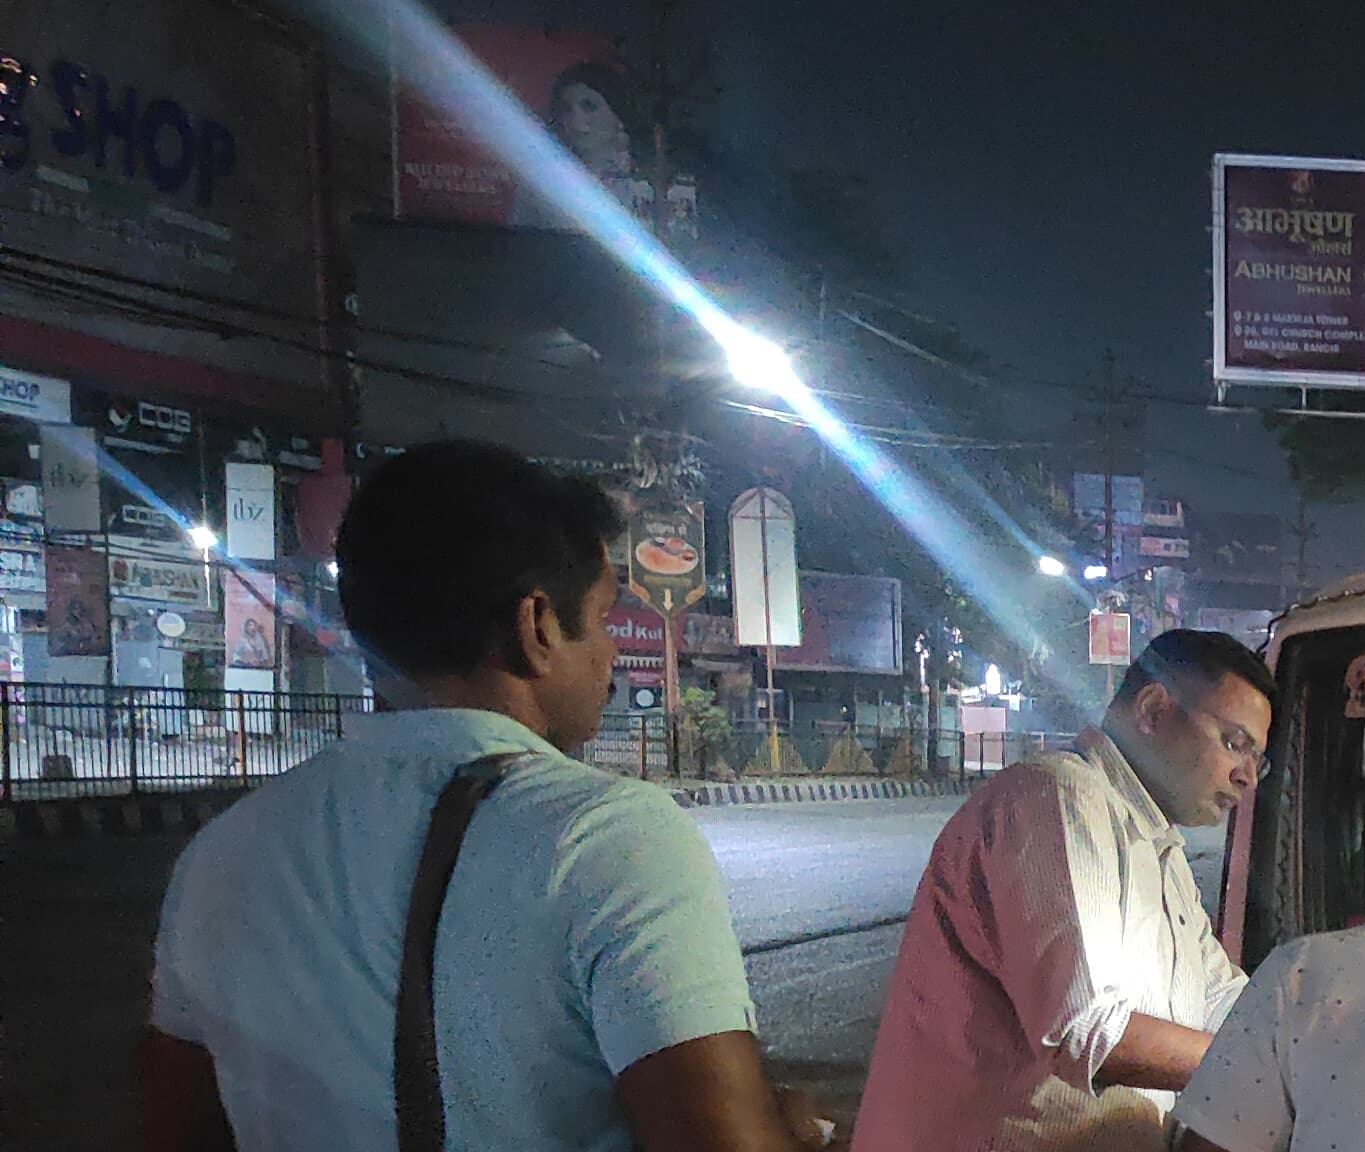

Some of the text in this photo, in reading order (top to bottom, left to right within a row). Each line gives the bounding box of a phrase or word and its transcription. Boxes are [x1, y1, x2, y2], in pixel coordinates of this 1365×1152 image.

[50, 61, 235, 207] SHOP
[1235, 206, 1355, 243] आभूषण
[1235, 260, 1351, 283] ABHUSHAN
